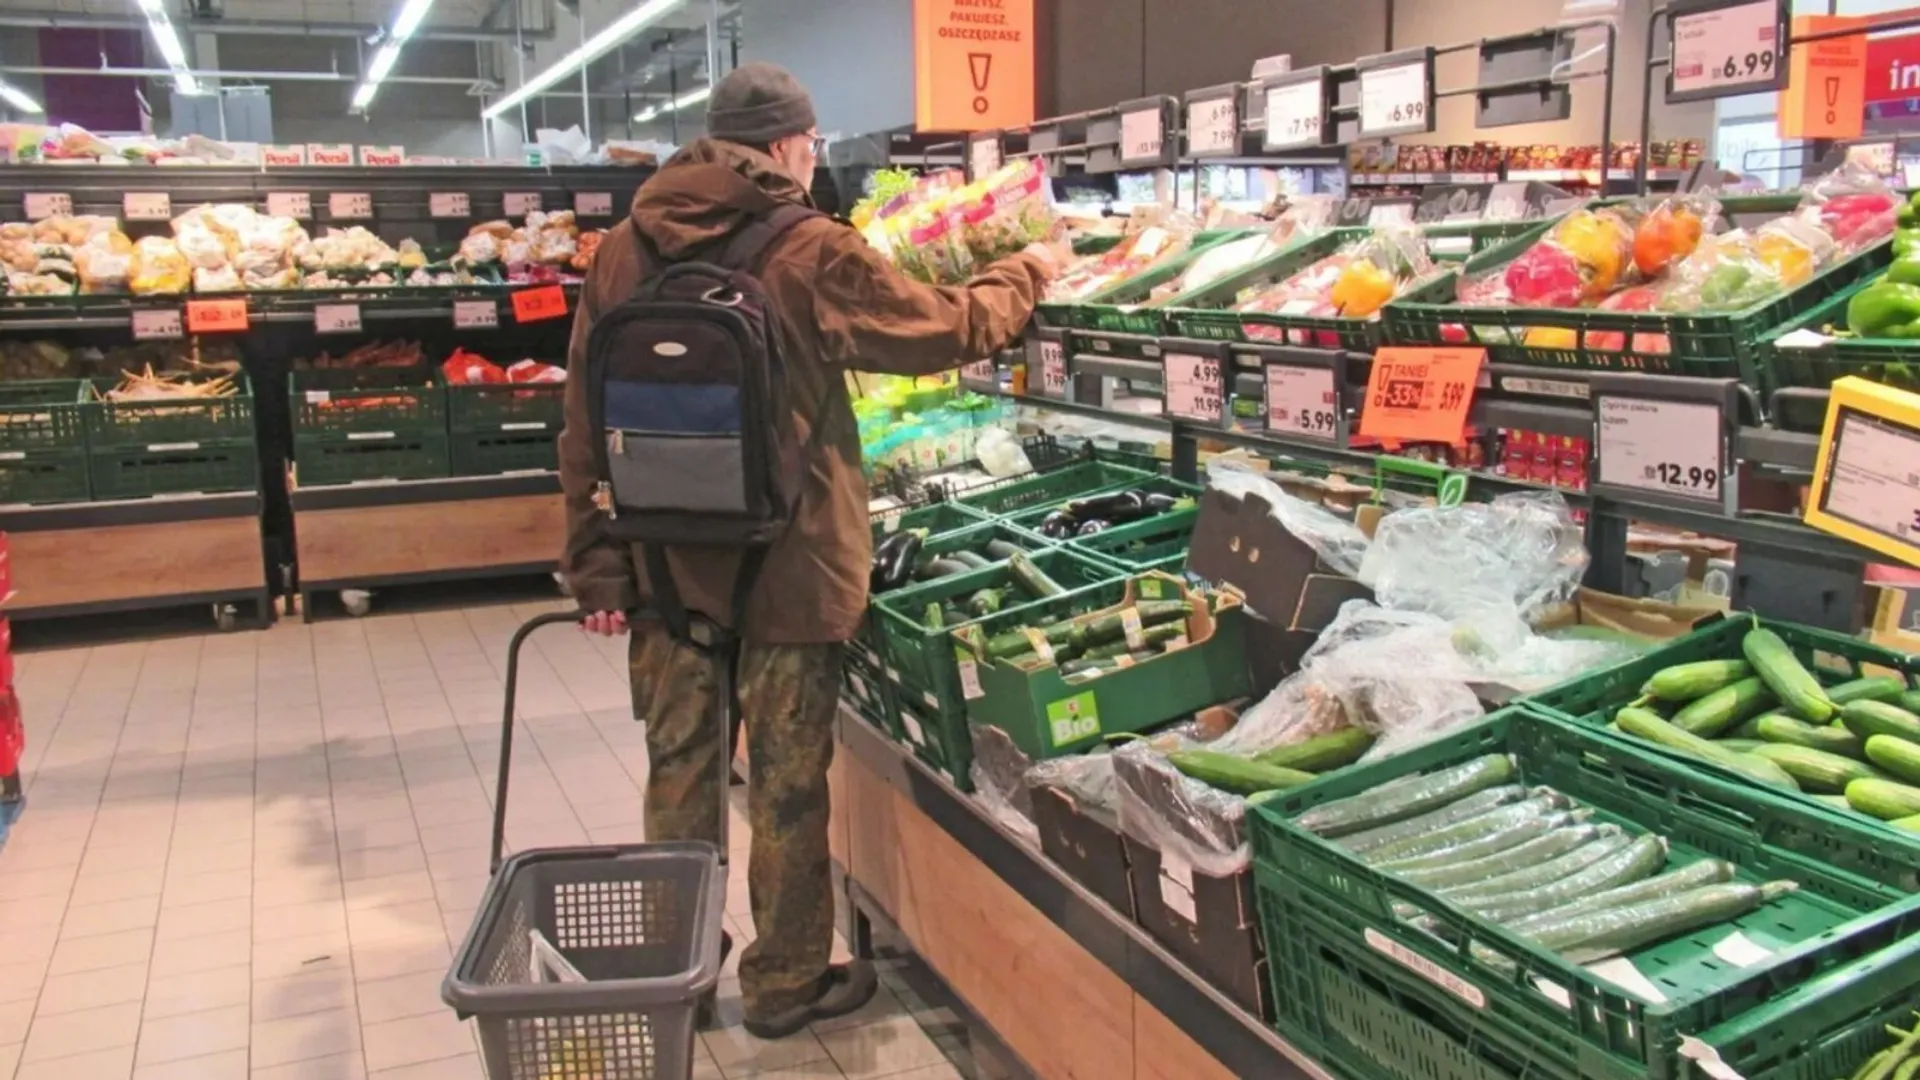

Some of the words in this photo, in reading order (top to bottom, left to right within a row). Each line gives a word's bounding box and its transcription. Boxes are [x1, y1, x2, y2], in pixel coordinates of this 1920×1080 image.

[938, 27, 1021, 42] OSZCZĘDZASZ
[1723, 50, 1774, 78] 6.99
[1393, 102, 1423, 121] 6.99
[1293, 116, 1319, 134] 7.99
[265, 152, 300, 165] Persil
[314, 151, 349, 165] Persil
[366, 153, 400, 165] Persil
[1193, 364, 1220, 382] 4.99
[1194, 396, 1221, 413] 11.99
[1301, 409, 1334, 431] 5.99
[1657, 461, 1717, 490] 12.99
[1053, 716, 1096, 742] Bio
